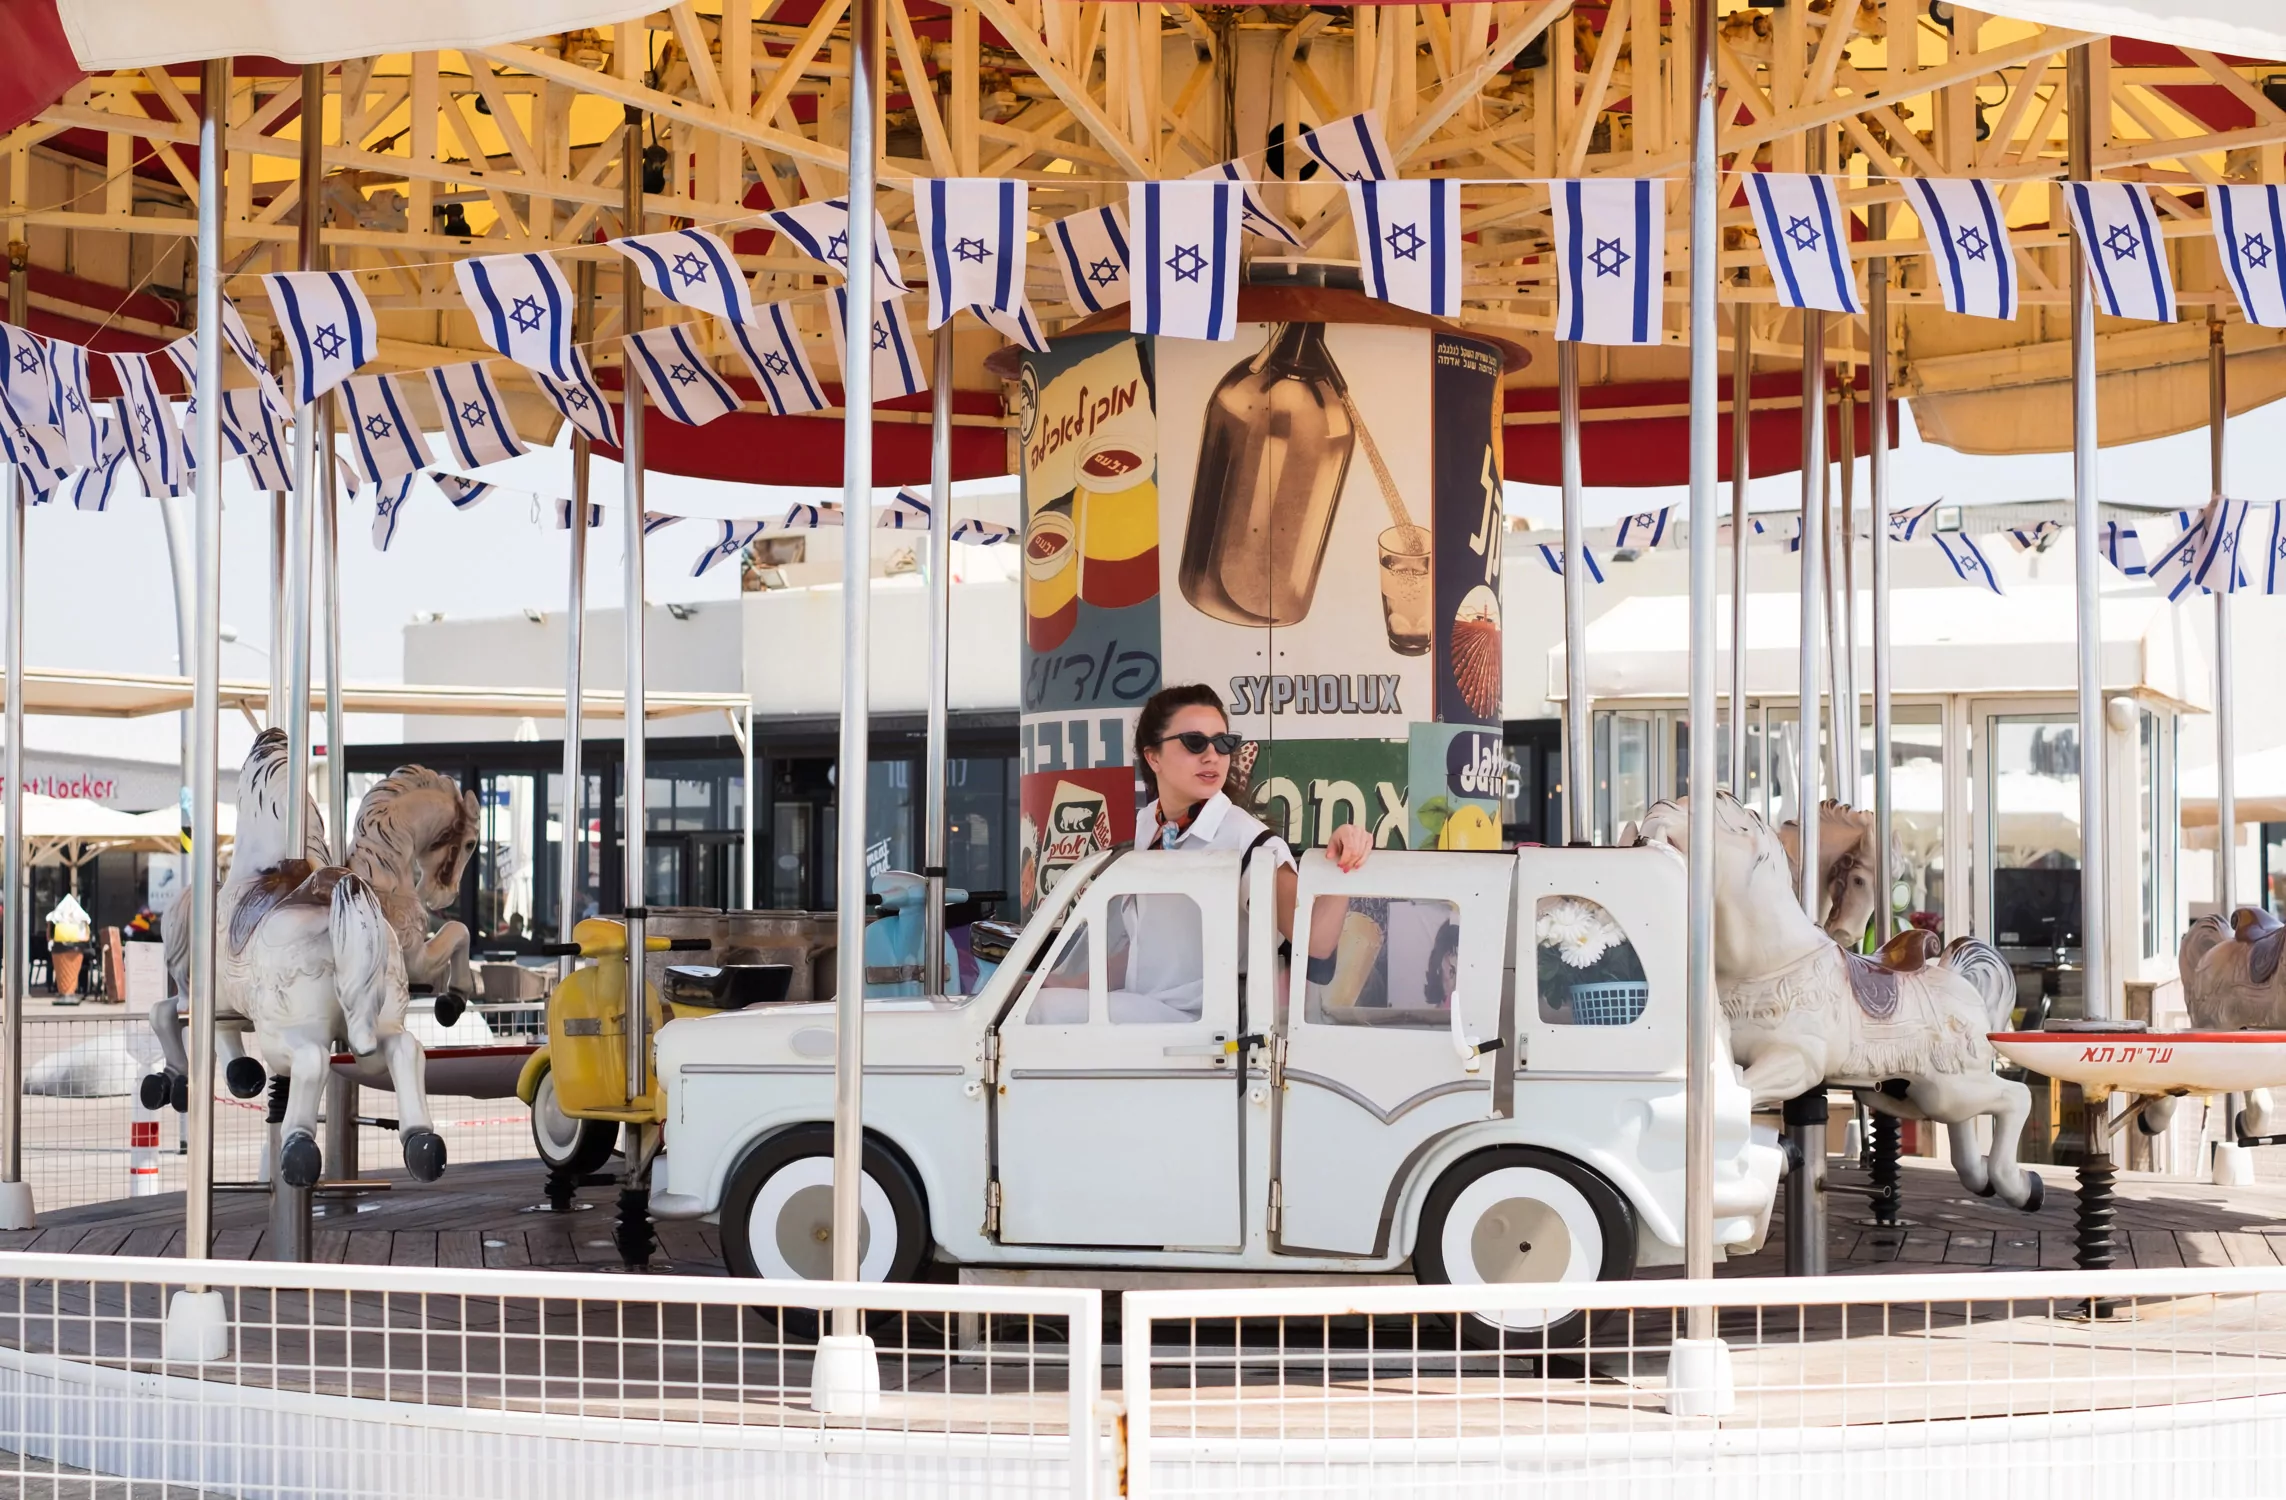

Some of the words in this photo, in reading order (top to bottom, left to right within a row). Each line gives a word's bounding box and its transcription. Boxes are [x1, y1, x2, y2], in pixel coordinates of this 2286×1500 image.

[1438, 356, 1460, 367] אדמה
[1031, 385, 1089, 472] לאכילה
[1089, 379, 1138, 437] מוכן
[1025, 638, 1160, 711] פודינג
[1230, 674, 1403, 716] SYPHOLUX
[1020, 718, 1138, 774] נובה
[1461, 733, 1503, 796] Jaff
[48, 772, 113, 799] Locker
[866, 839, 890, 868] meat
[1047, 834, 1087, 862] ארטיק
[2079, 1047, 2115, 1063] תא
